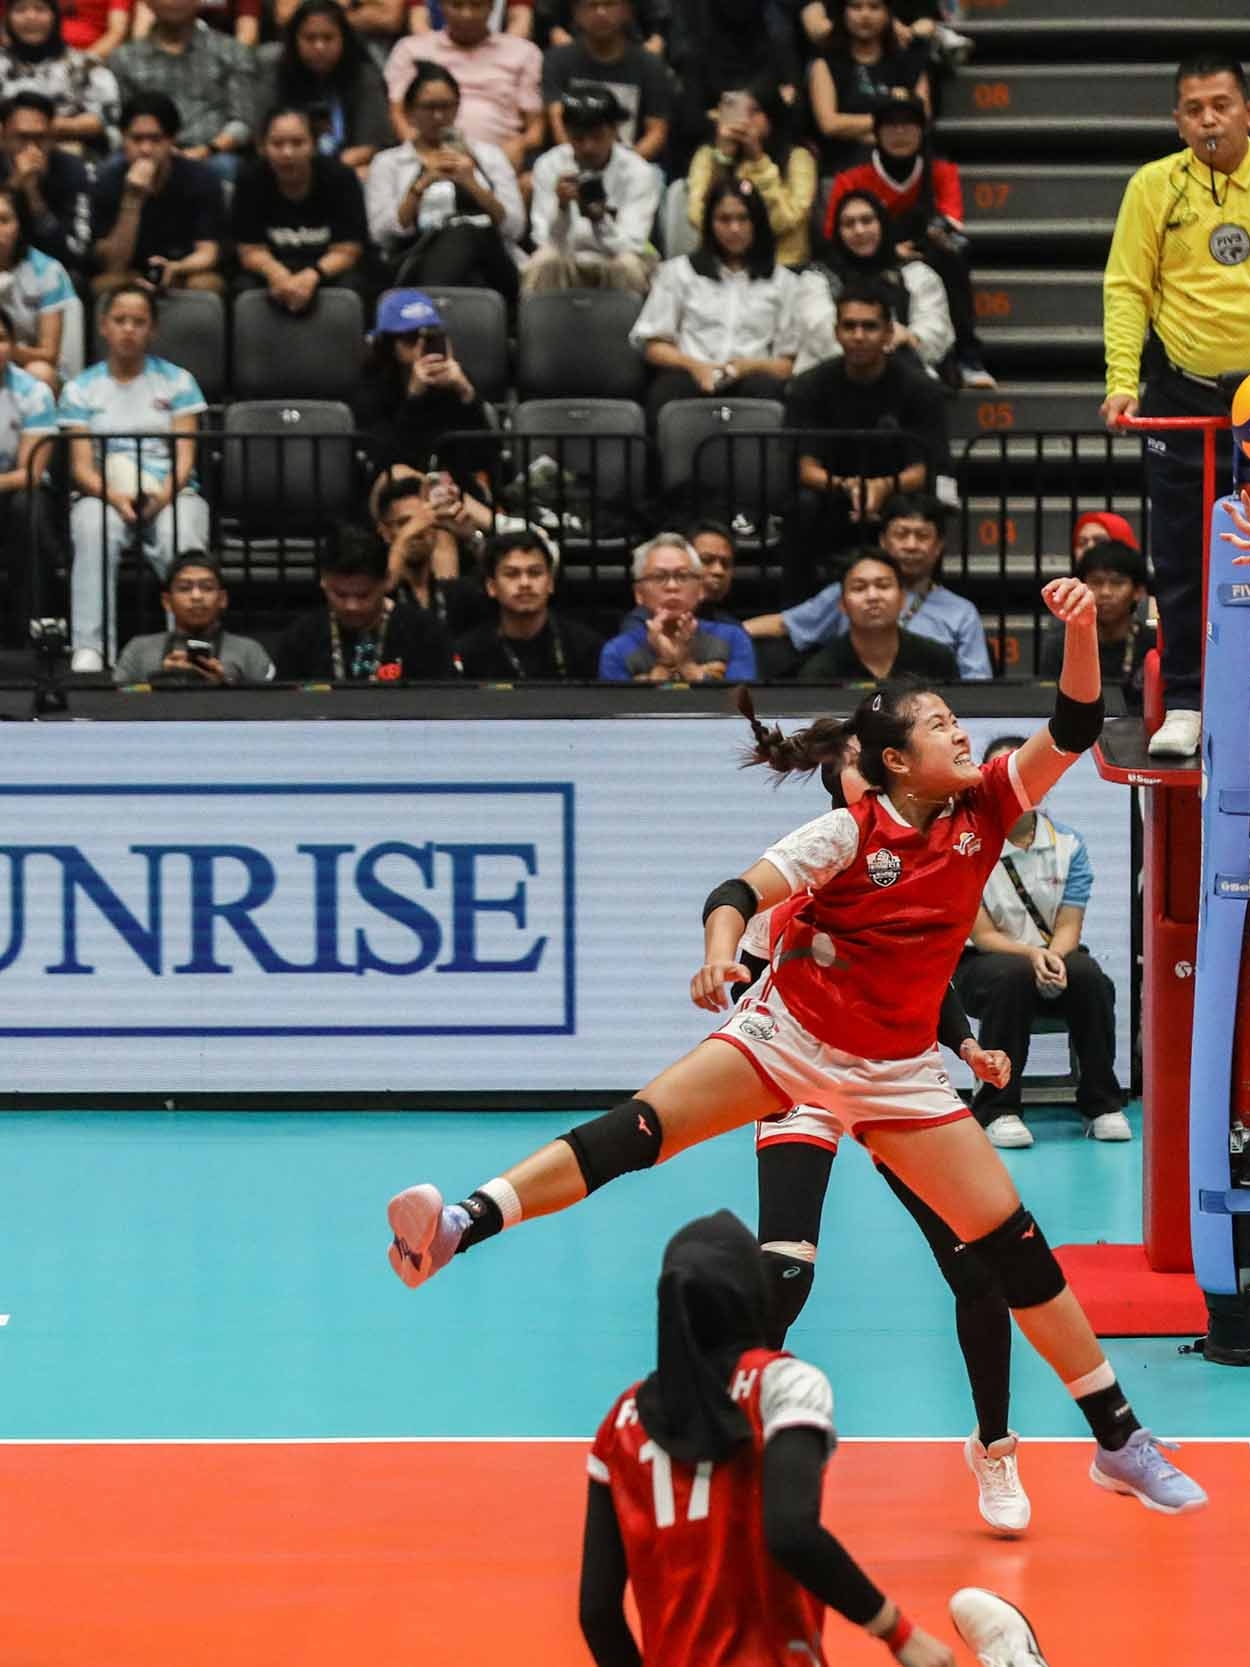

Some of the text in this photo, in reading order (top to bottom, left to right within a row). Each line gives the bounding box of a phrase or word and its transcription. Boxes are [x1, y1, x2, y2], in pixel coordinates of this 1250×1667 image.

[974, 182, 1009, 208] 07
[977, 403, 1014, 428] 05
[730, 1368, 758, 1401] H
[639, 1439, 713, 1529] 17
